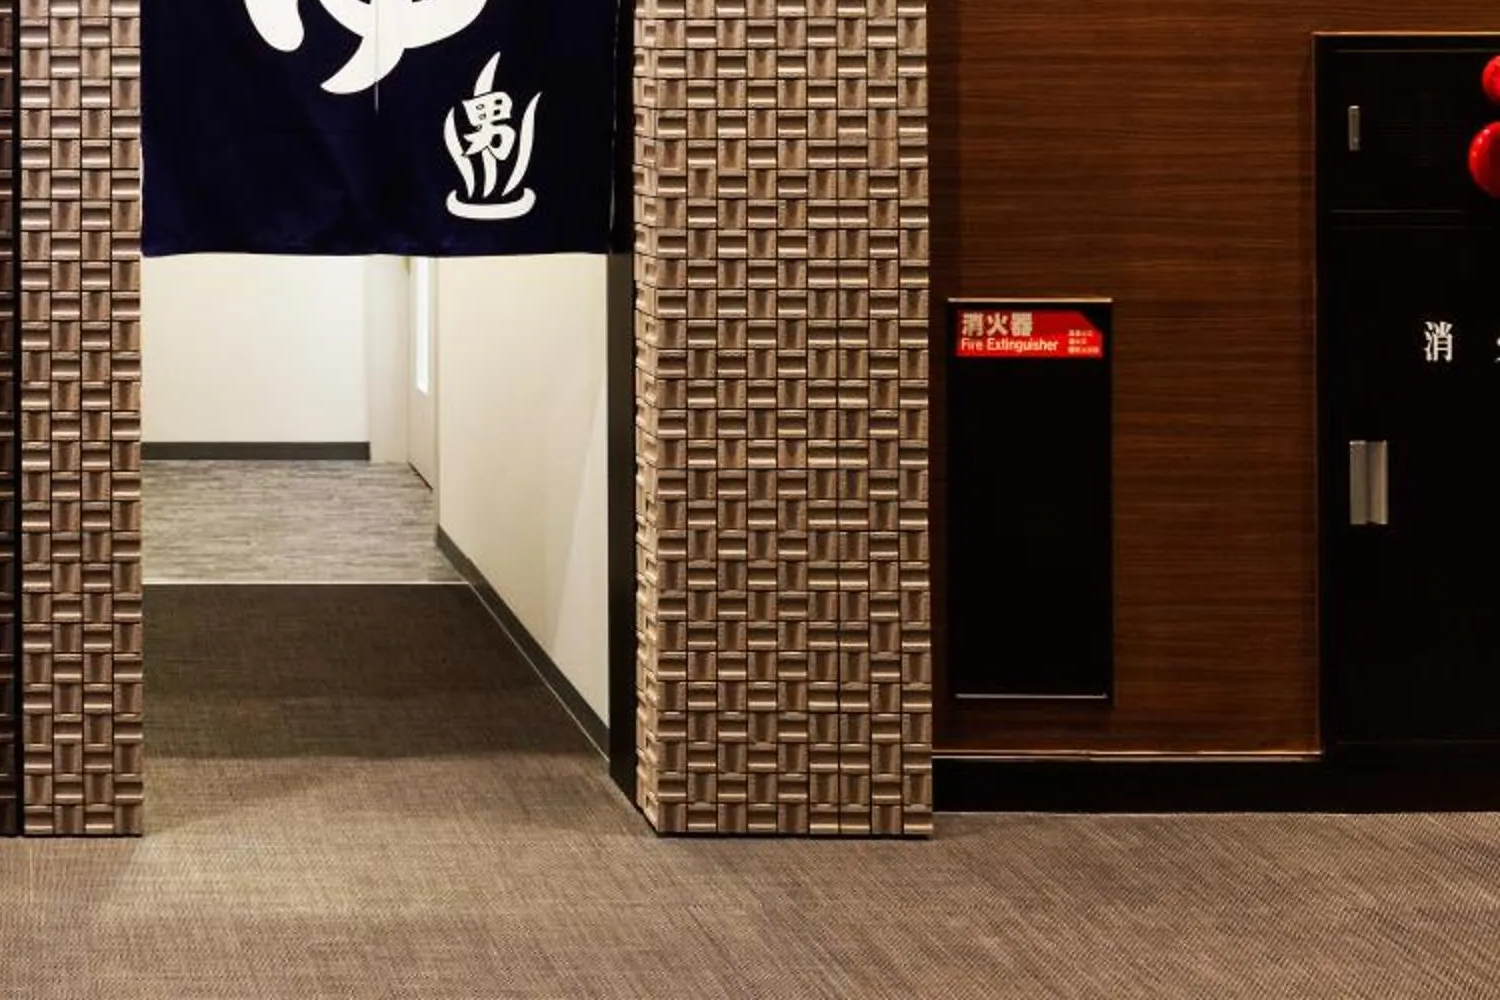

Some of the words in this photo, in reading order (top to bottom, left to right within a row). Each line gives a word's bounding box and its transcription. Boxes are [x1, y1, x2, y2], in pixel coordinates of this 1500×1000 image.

[461, 91, 516, 161] 男
[961, 312, 1033, 337] 消火器
[961, 338, 983, 351] Fire
[987, 338, 1059, 353] Extinguisher
